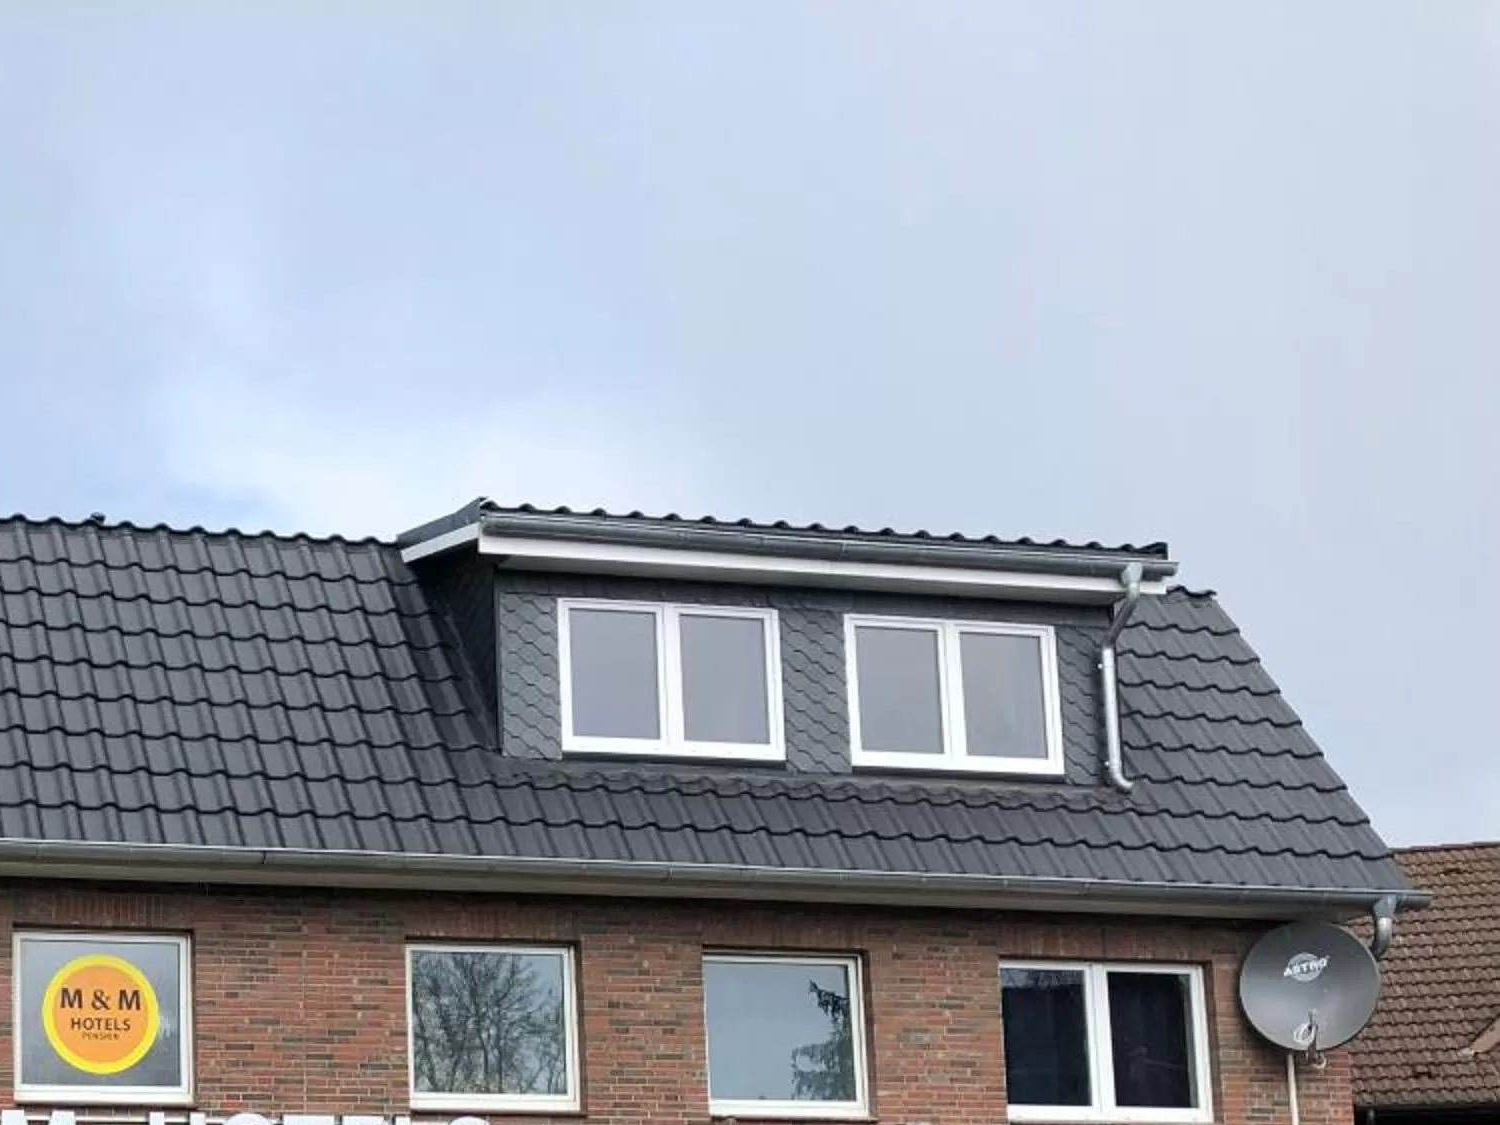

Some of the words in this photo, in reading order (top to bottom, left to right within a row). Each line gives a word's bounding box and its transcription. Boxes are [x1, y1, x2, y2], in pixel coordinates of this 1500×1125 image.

[60, 987, 83, 1009] M
[91, 989, 111, 1010] &
[118, 989, 141, 1011] M
[70, 1017, 132, 1031] HOTELS
